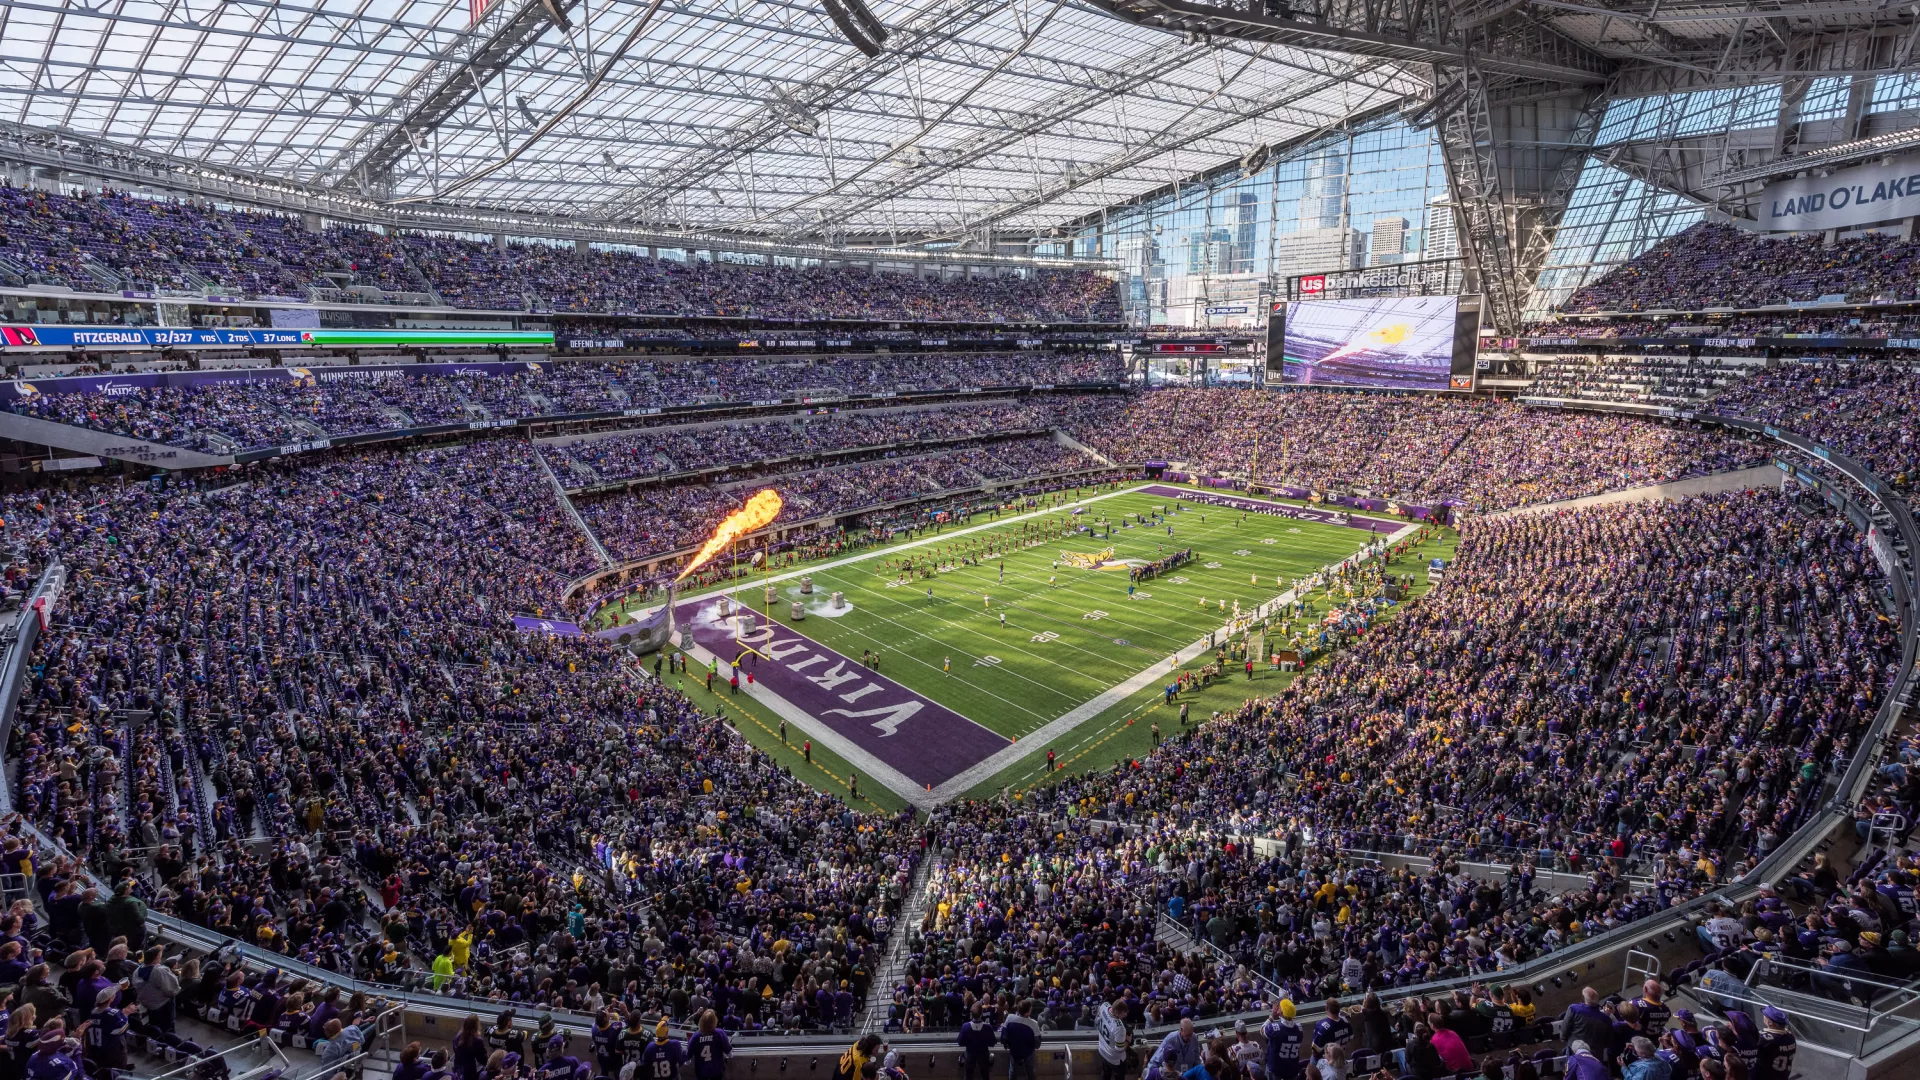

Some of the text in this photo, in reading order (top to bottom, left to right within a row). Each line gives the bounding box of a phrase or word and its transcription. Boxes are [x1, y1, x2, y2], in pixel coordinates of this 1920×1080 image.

[1771, 193, 1826, 218] LAND
[73, 332, 142, 343] FITZGERALD
[155, 330, 193, 344] 32/327
[201, 334, 216, 342] YDS
[264, 333, 275, 342] 37
[1705, 338, 1726, 346] DEFEND
[570, 340, 594, 348] DEFEND
[604, 340, 624, 348] NORTH
[470, 421, 490, 429] DEFEND
[105, 445, 150, 456] 225-242
[280, 444, 301, 454] DEFEND
[312, 440, 331, 449] NORTH
[1030, 631, 1060, 643] 20
[972, 655, 1002, 667] 10
[383, 961, 397, 971] 12
[1348, 968, 1359, 977] 28
[1491, 1017, 1514, 1033] 87
[87, 1027, 102, 1046] 19
[598, 1045, 610, 1058] 4
[700, 1045, 712, 1062] 4
[1279, 1042, 1300, 1059] 55
[652, 1061, 671, 1078] 18
